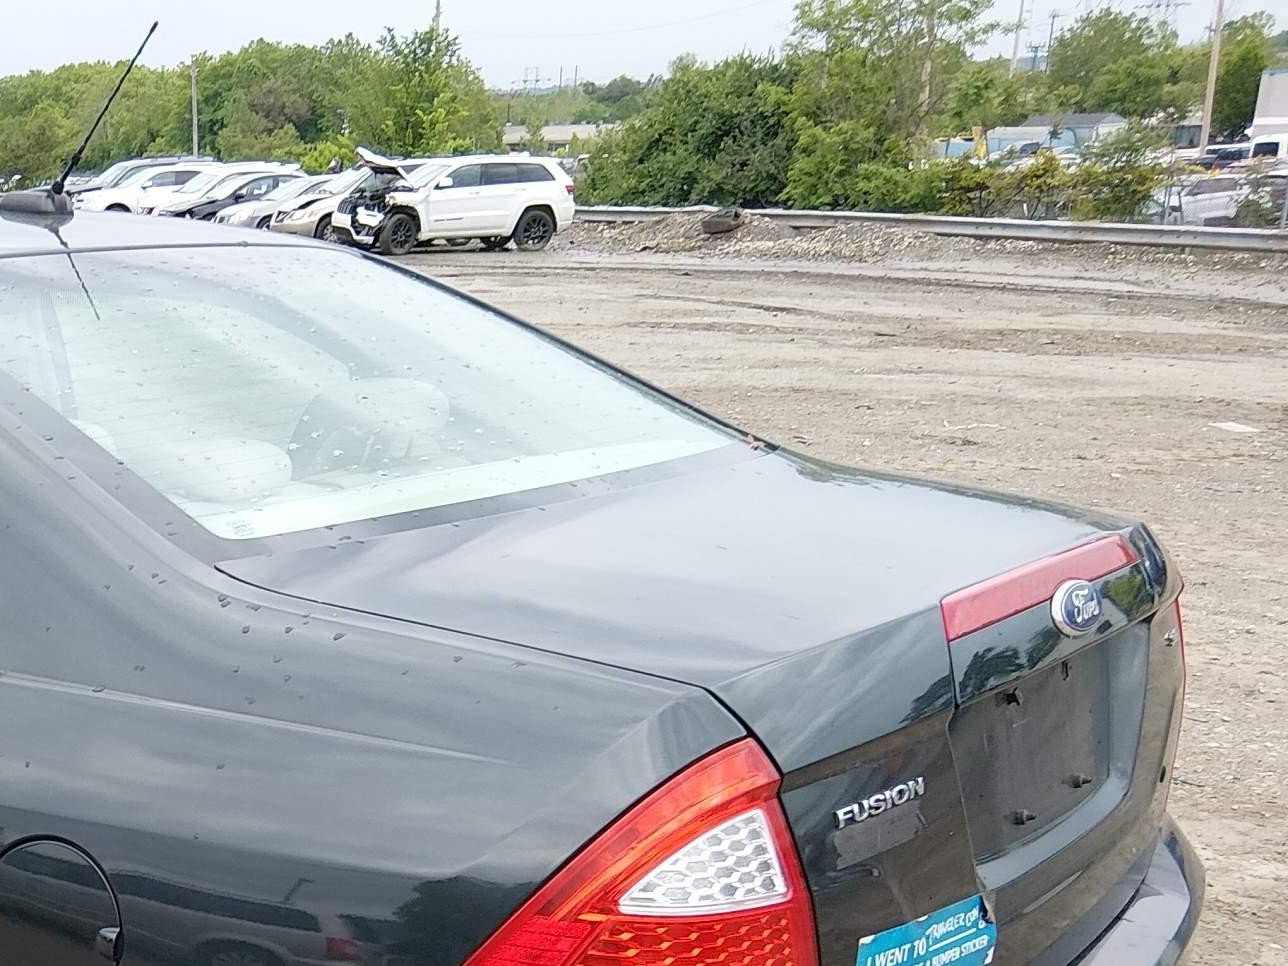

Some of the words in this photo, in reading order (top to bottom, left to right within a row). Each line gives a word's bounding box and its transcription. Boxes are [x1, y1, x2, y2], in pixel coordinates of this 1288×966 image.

[1071, 588, 1100, 624] Ford
[833, 776, 926, 830] FUSION
[913, 936, 927, 959] TO
[961, 934, 989, 957] STICKER
